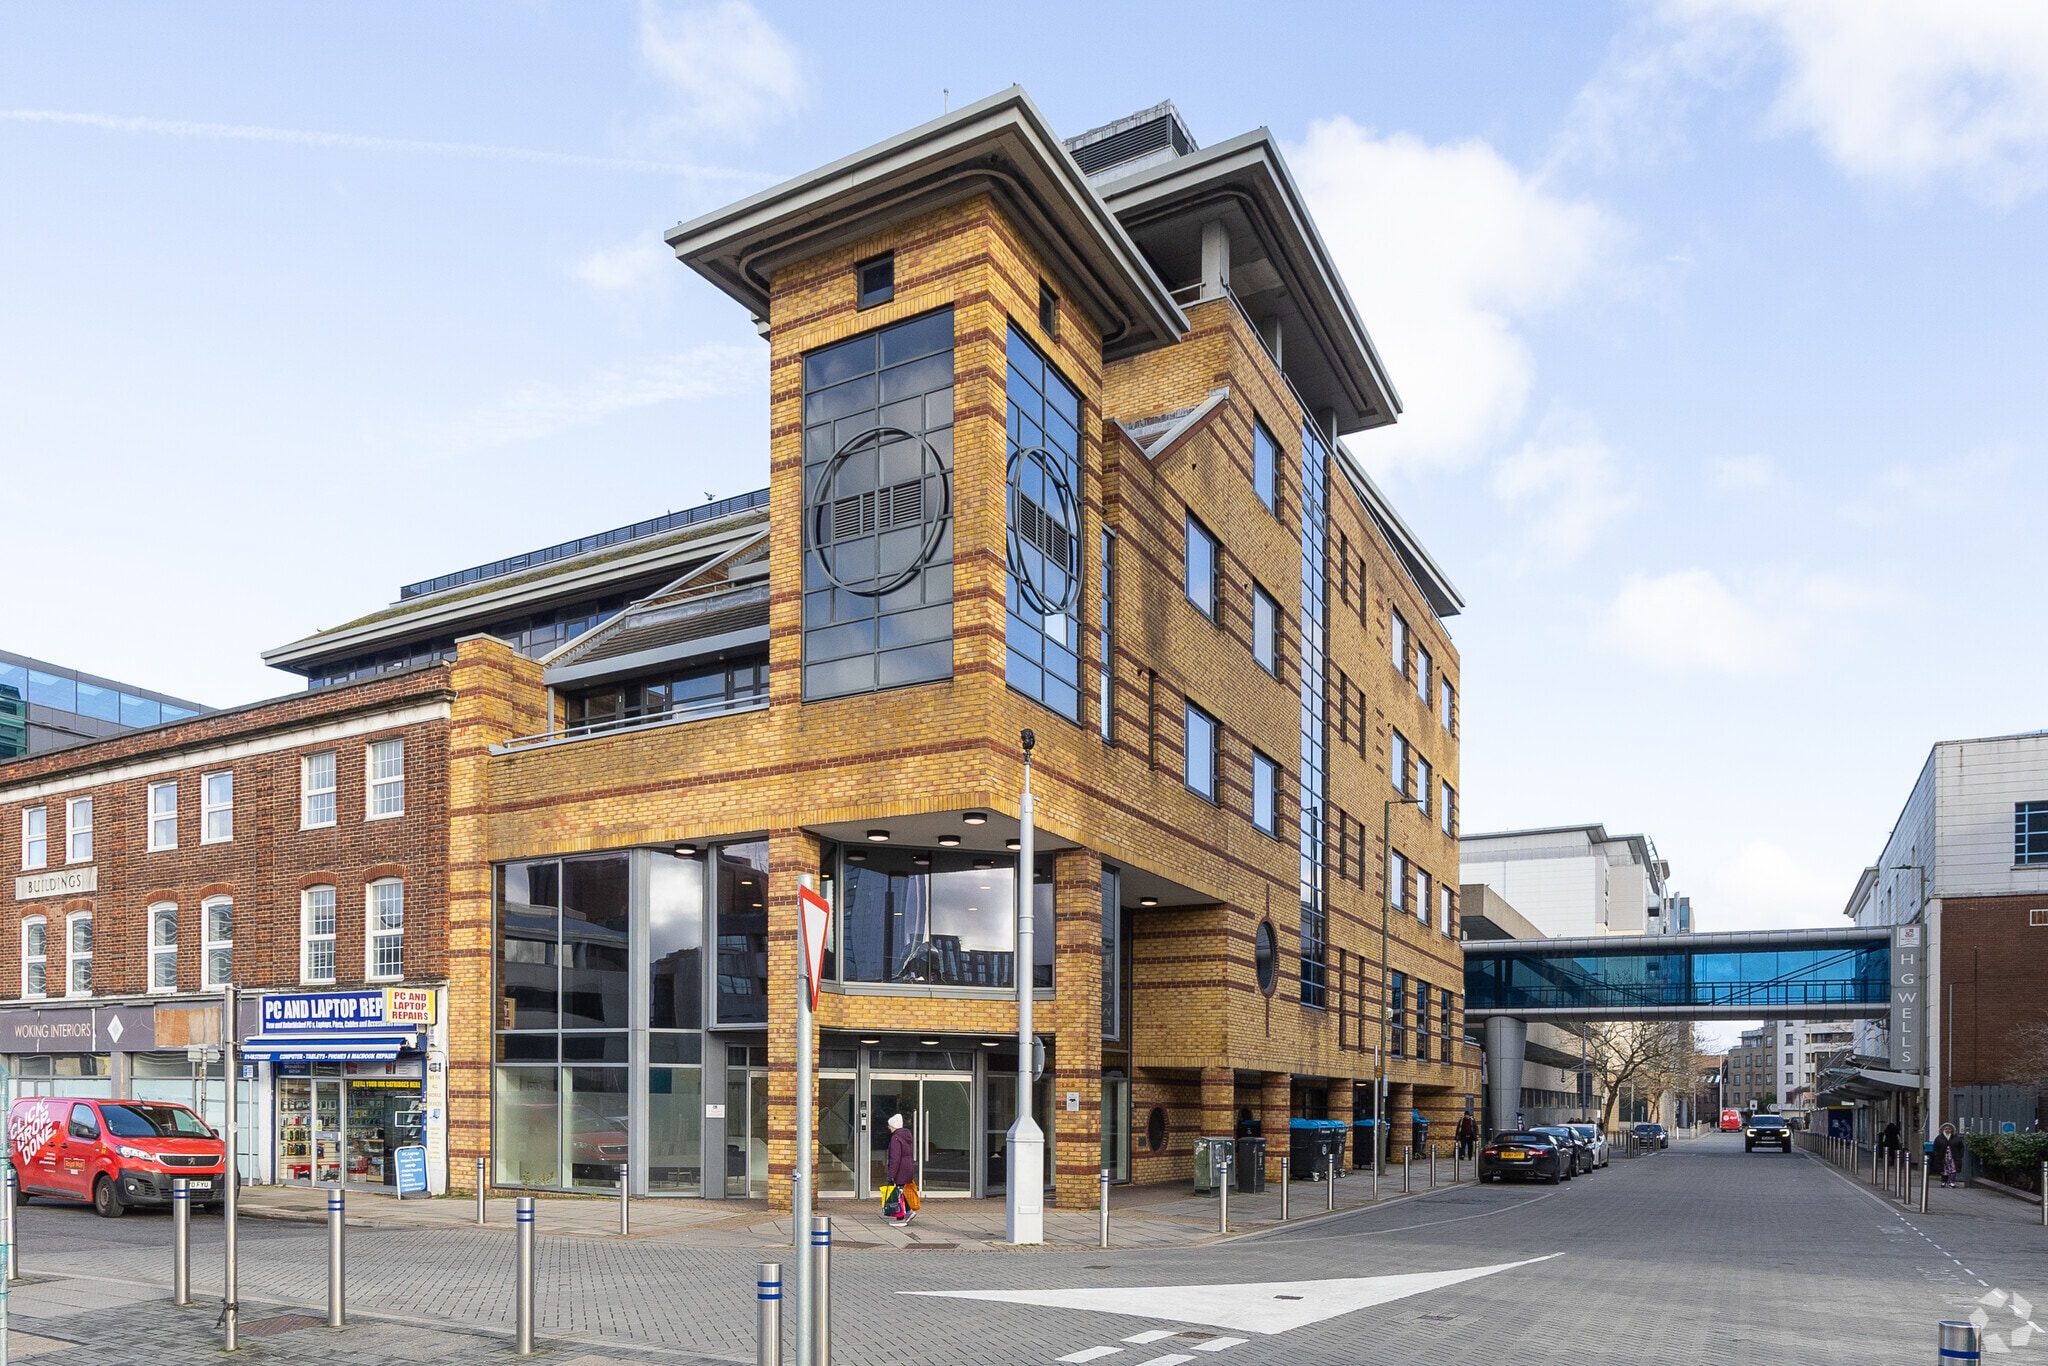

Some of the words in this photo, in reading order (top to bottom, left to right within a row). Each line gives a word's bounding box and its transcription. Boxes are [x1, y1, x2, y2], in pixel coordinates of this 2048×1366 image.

[28, 874, 81, 893] BUILDINGS
[394, 992, 407, 1001] PC
[409, 992, 427, 1001] AND
[265, 1000, 282, 1020] PC
[284, 999, 309, 1019] AND
[311, 998, 357, 1019] LAPTOP
[393, 1001, 427, 1011] LAPTOP
[392, 1010, 429, 1021] REPAIRS
[15, 1024, 49, 1038] WOKING
[50, 1023, 92, 1037] INTERIORS
[22, 1121, 57, 1166] DONE.
